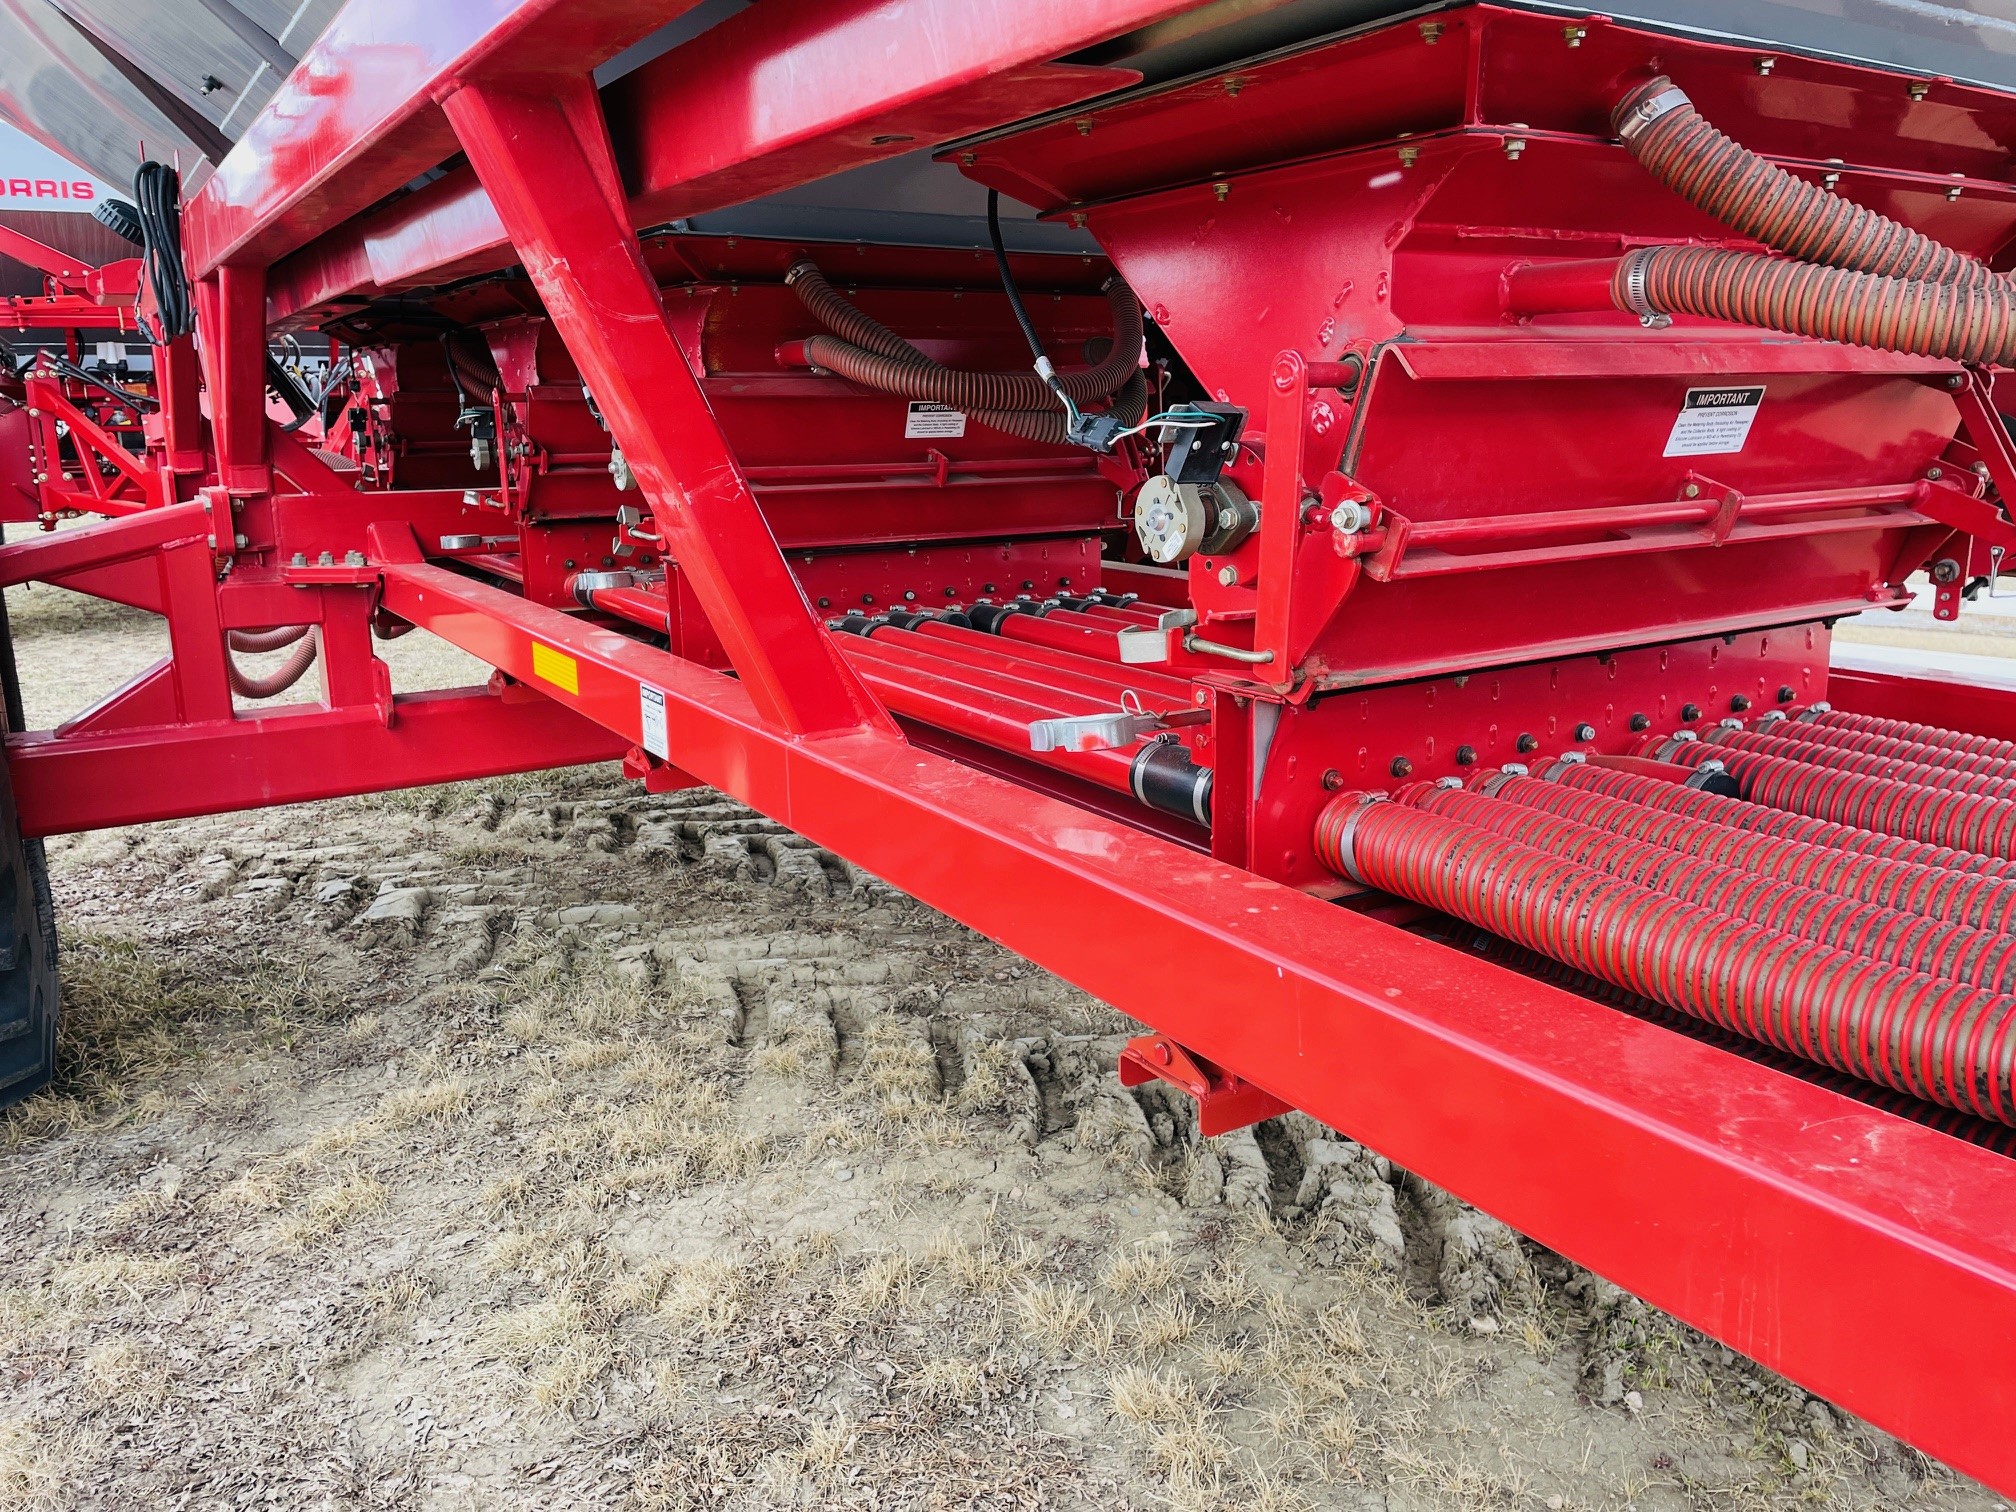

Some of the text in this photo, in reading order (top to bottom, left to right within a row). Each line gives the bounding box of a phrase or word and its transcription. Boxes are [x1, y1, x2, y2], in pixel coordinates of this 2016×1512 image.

[0, 178, 94, 199] RRIS
[1696, 392, 1751, 406] IMPORTANT
[918, 404, 955, 412] IMPORTA
